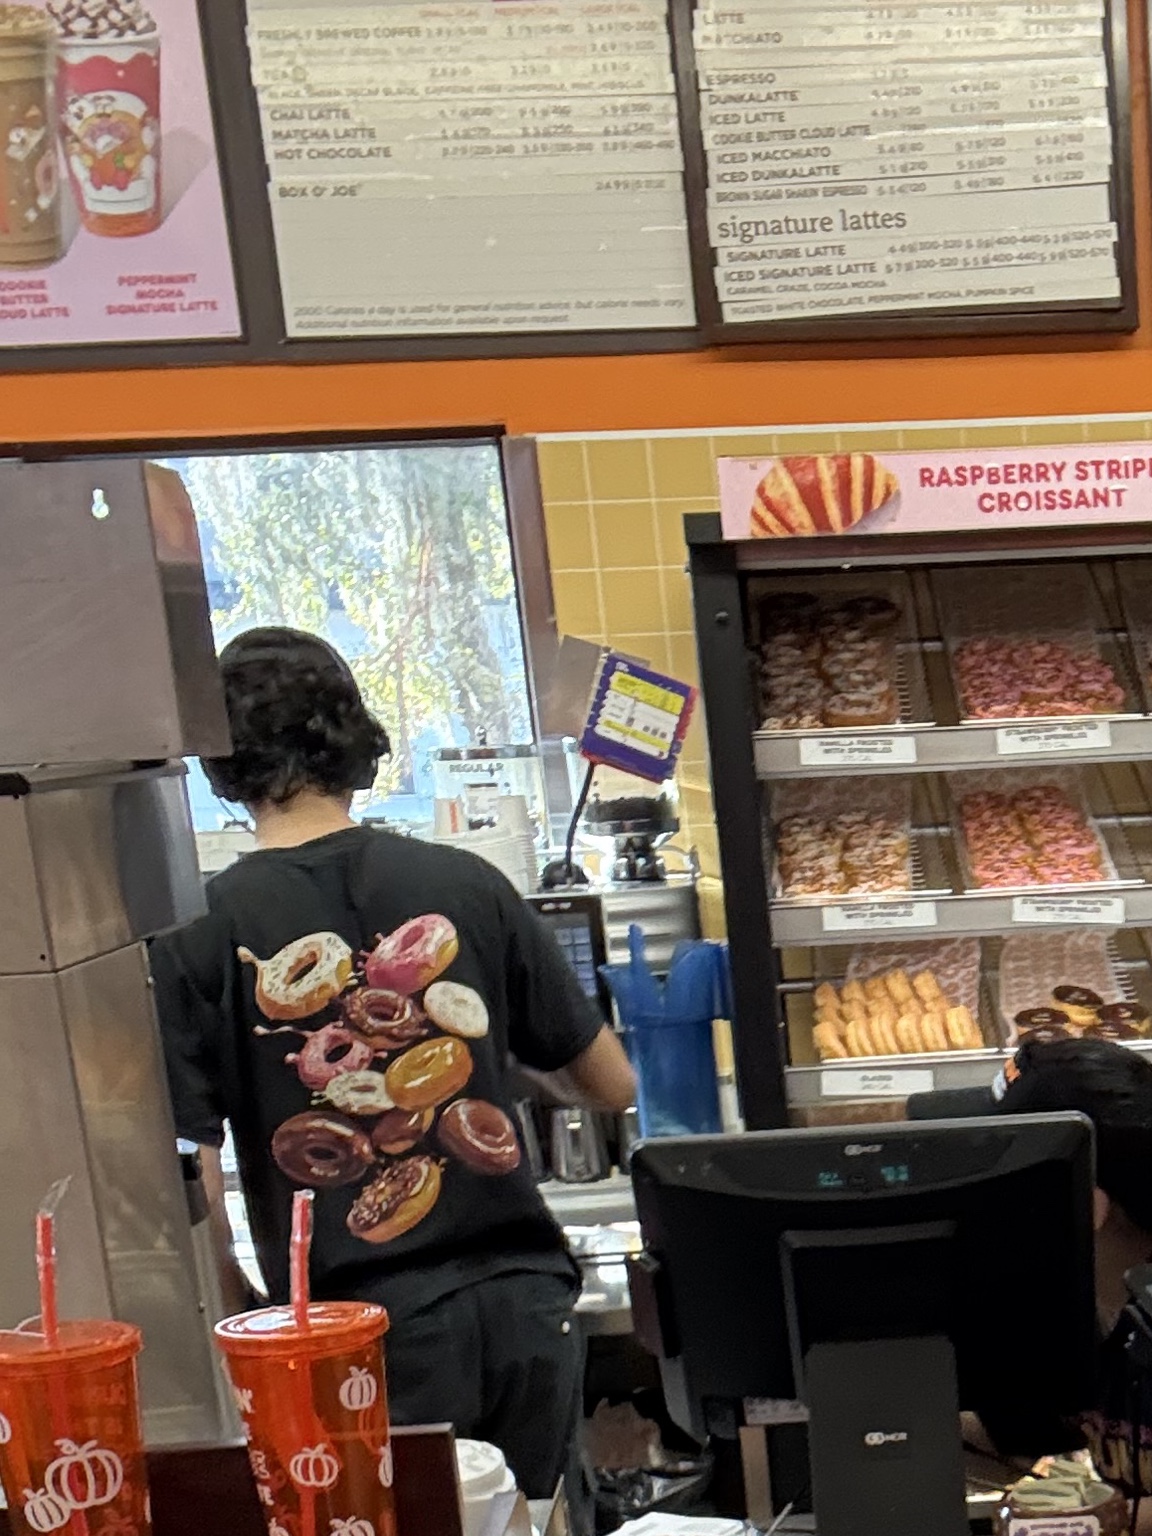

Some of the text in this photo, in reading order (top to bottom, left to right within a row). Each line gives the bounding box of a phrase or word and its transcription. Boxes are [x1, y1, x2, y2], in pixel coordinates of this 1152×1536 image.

[374, 26, 421, 38] COFFEE
[706, 73, 776, 85] ESPRESSO
[709, 90, 799, 105] DUNKALATTE
[270, 108, 351, 121] CHAI LATTE
[709, 111, 785, 125] ICED LATTE
[272, 127, 377, 140] MATCHA LATTE
[713, 125, 871, 145] COOKIE BUTTER CLOUD LATTE
[274, 146, 393, 160] HOT CHOCOLATE
[717, 146, 831, 164] ICED MACCHIATO
[716, 165, 841, 183] ICED DUNKALATTE
[278, 186, 308, 198] BOX
[717, 208, 908, 244] signature lattes
[727, 245, 847, 263] SIGNATURE LATTE
[724, 262, 878, 282] ICED SIGNATURE LATTE
[118, 273, 196, 287] PEPPERMINT
[851, 280, 887, 289] MOCHA
[136, 289, 184, 300] MOCHA
[31, 307, 70, 318] LATTE
[106, 300, 218, 316] SIGNATURE LATTE
[919, 460, 1066, 488] RASPBERRY
[977, 484, 1128, 514] CROISSANT
